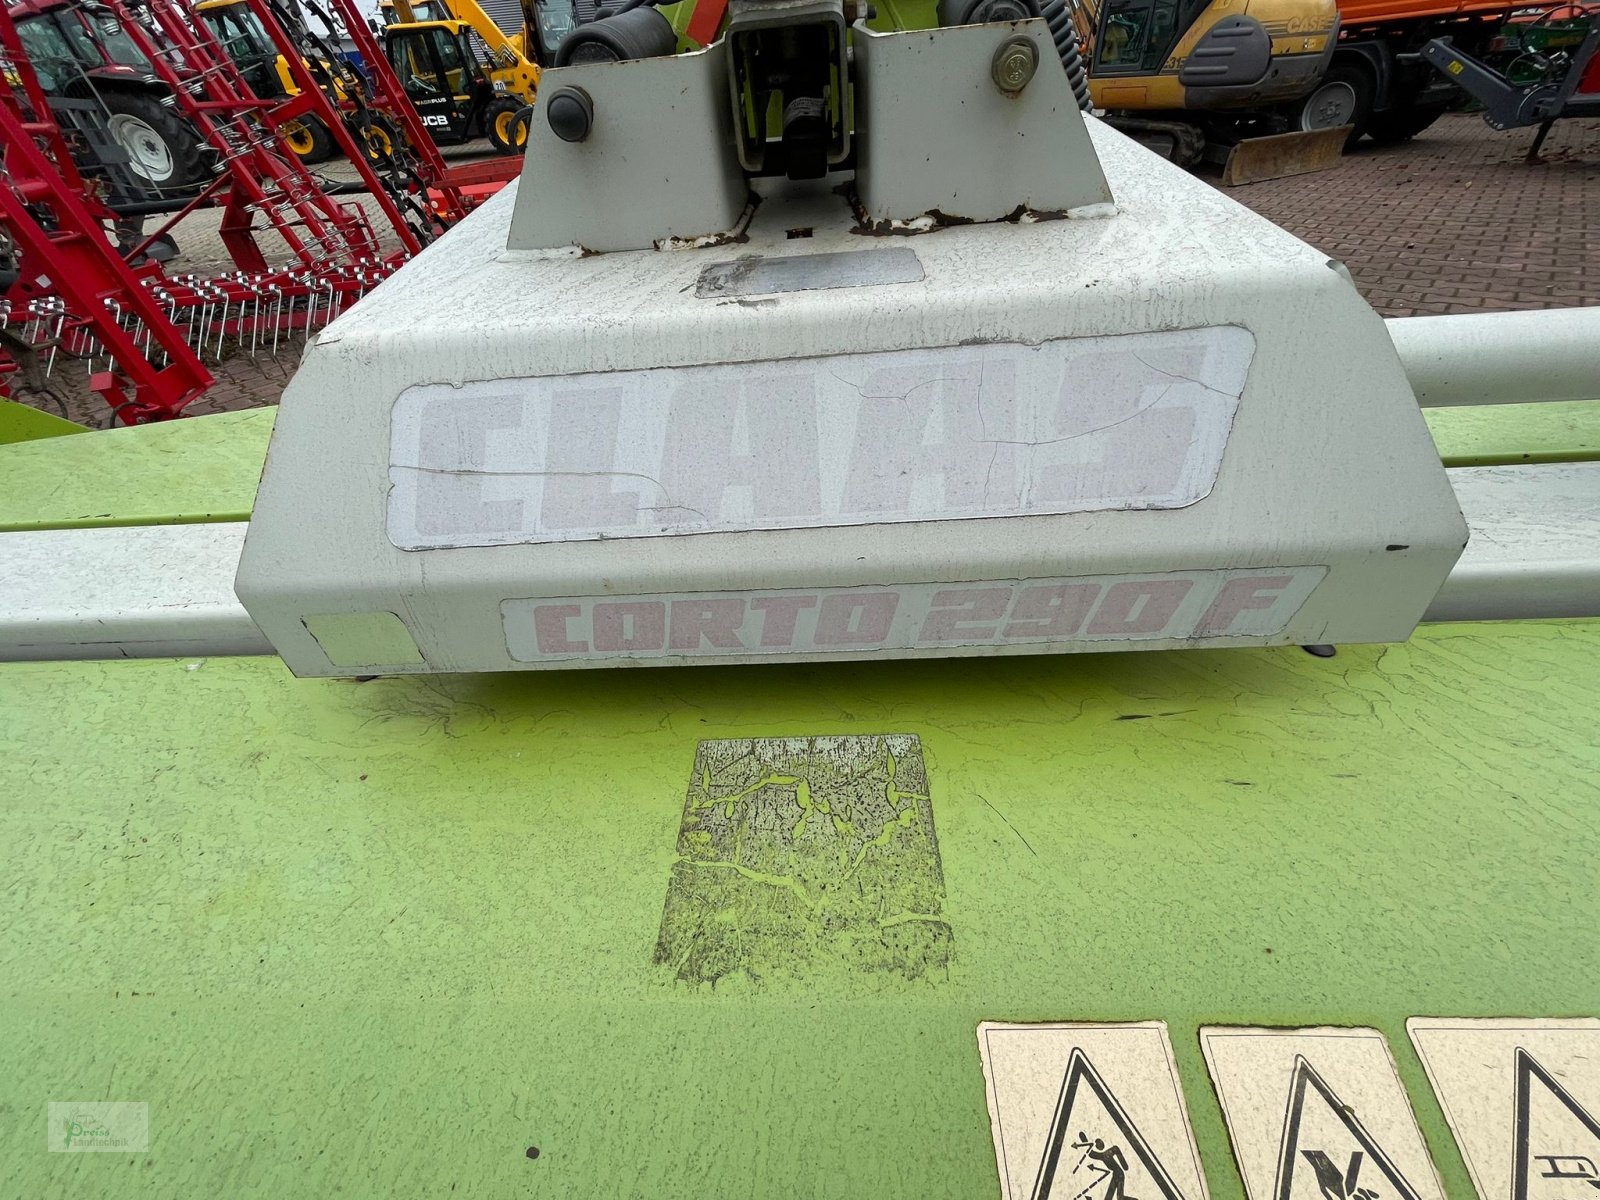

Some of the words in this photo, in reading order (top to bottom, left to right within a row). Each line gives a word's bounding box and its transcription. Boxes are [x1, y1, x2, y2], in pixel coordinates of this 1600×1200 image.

[1287, 15, 1329, 33] CASE
[418, 115, 449, 127] JCB
[415, 345, 1210, 536] CLAAS
[533, 592, 899, 653] CORTO
[918, 579, 1194, 642] 290
[1194, 575, 1294, 635] F
